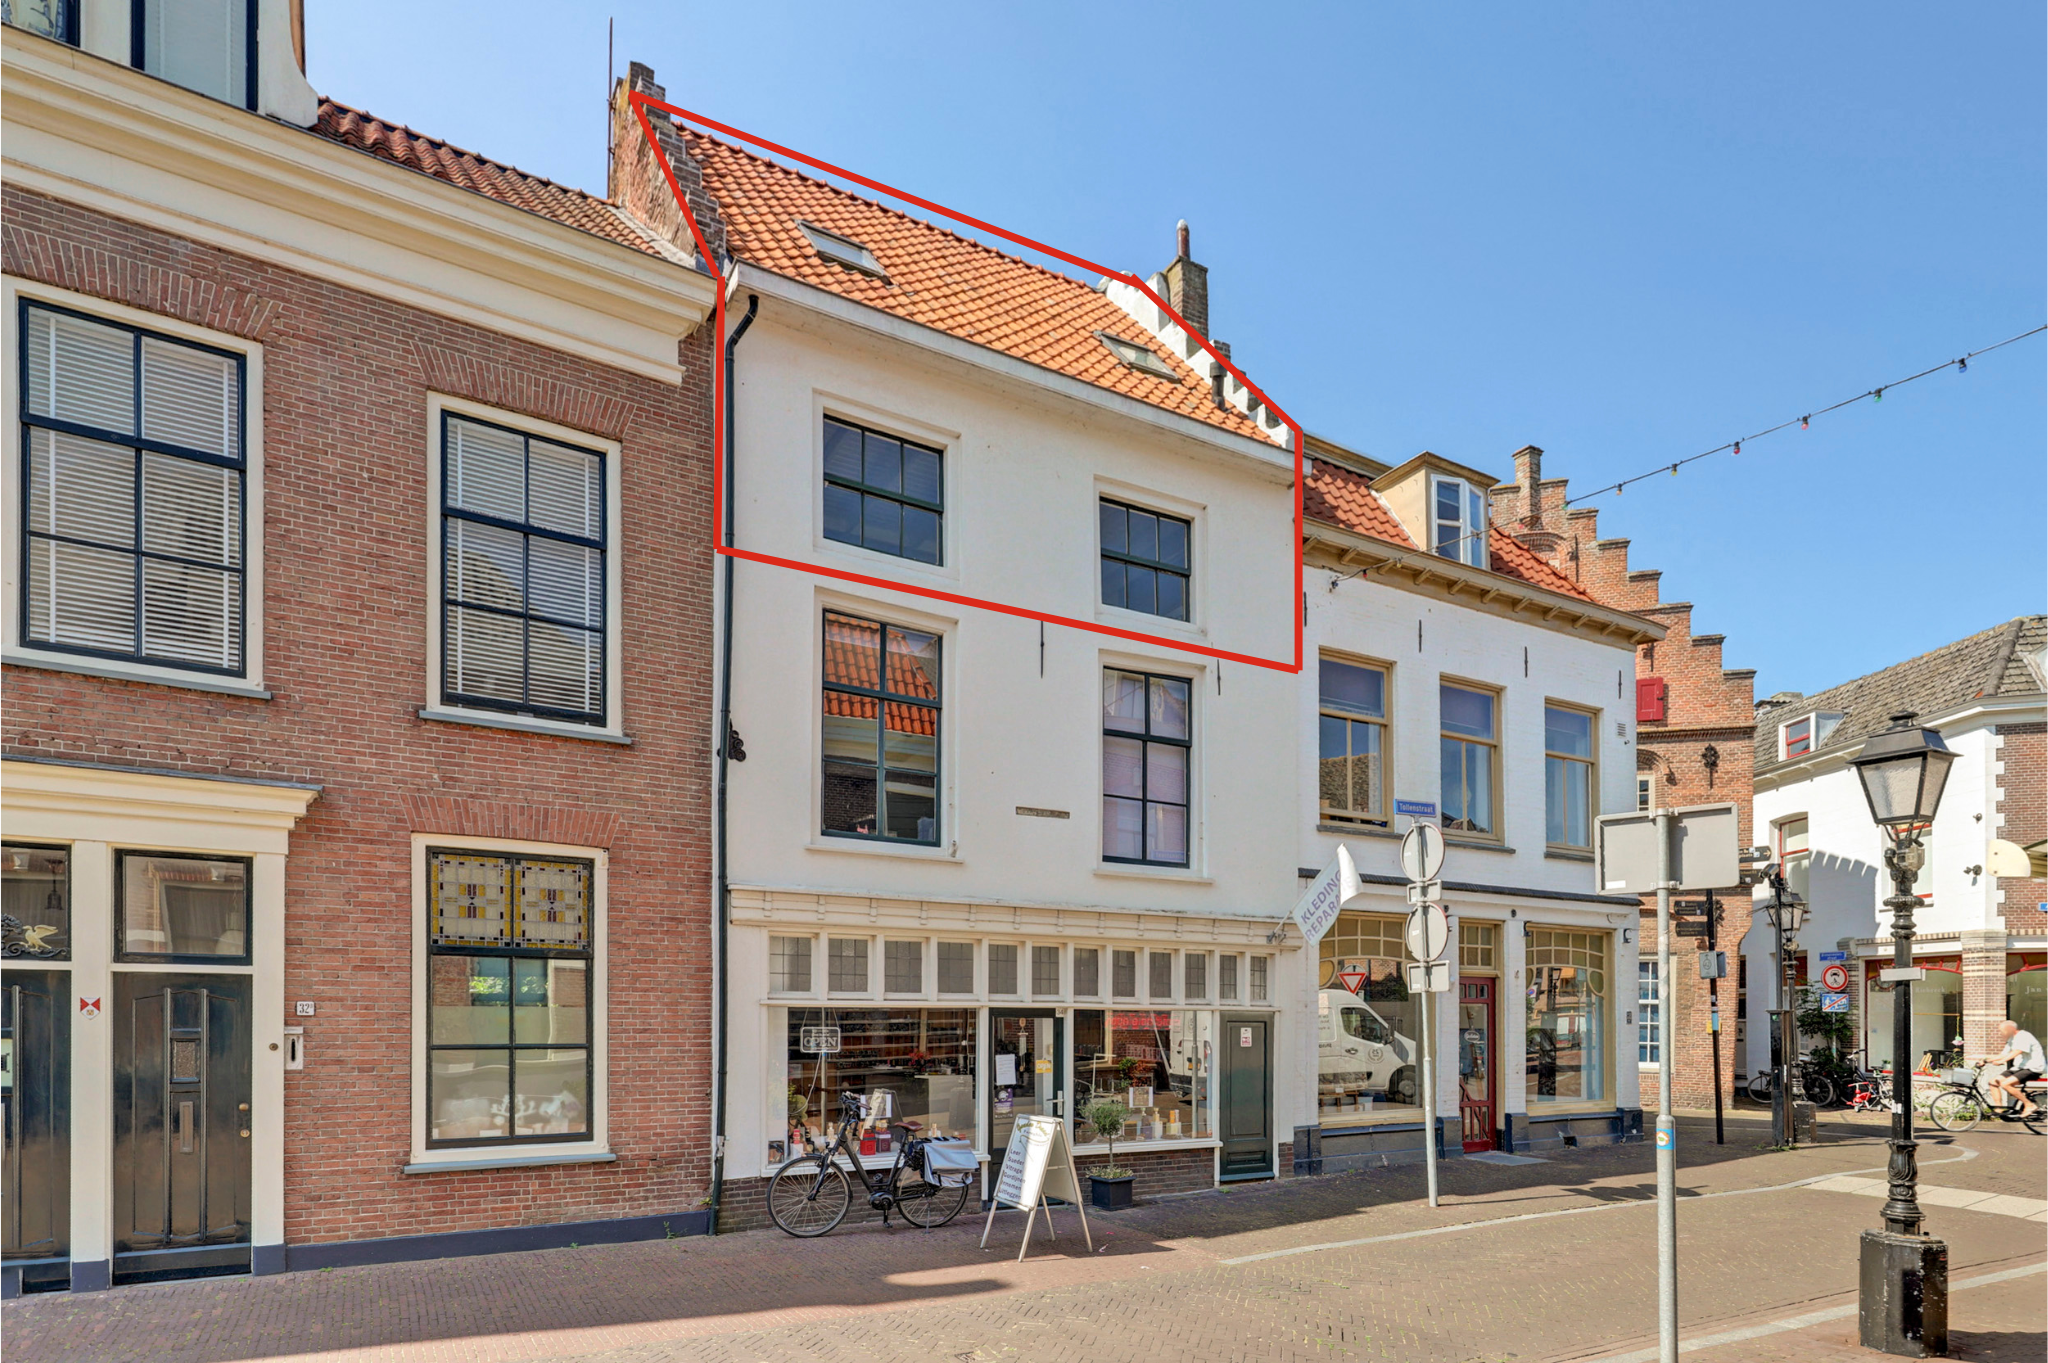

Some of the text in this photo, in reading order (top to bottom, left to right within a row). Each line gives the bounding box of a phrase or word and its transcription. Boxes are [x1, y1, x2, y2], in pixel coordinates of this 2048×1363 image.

[1398, 802, 1434, 813] Tollenstraat
[2024, 985, 2042, 995] Jan
[803, 1036, 837, 1047] OPEN
